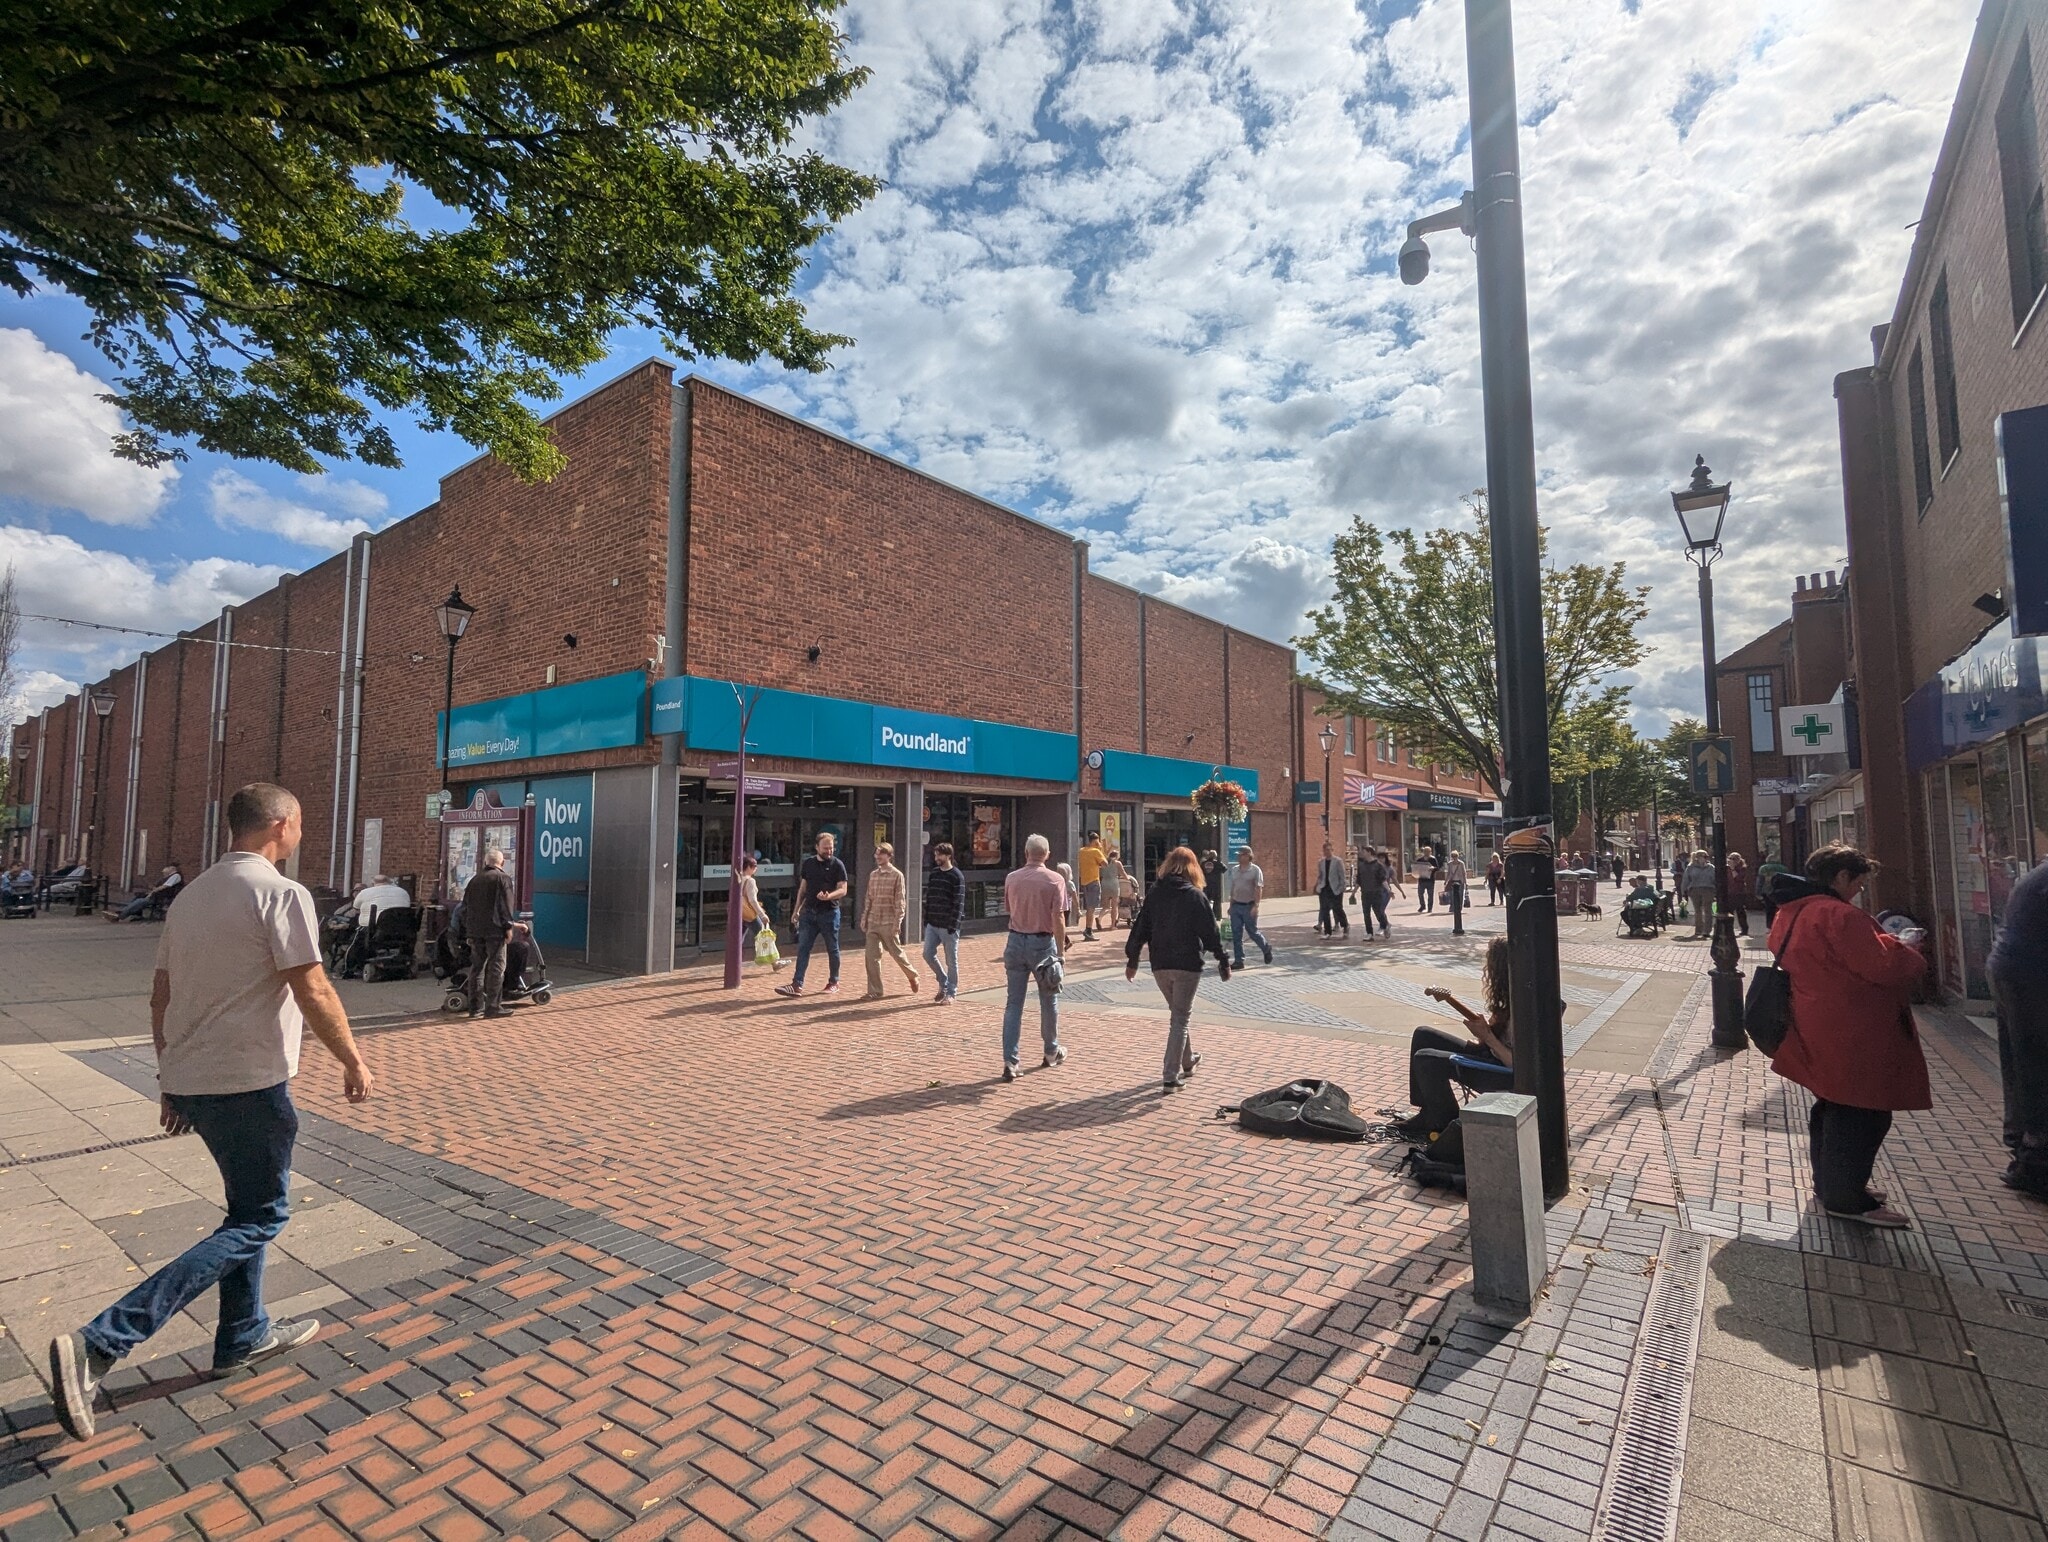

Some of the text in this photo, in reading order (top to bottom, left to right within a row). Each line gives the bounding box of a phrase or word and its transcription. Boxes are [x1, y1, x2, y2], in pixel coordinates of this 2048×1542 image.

[655, 700, 681, 711] Poundland
[467, 742, 486, 756] Value
[486, 740, 505, 755] Every
[882, 727, 967, 755] Poundland
[1430, 794, 1461, 806] PEACOCKS
[459, 810, 503, 820] INFORMATION
[544, 797, 581, 825] Now
[540, 830, 583, 864] Open
